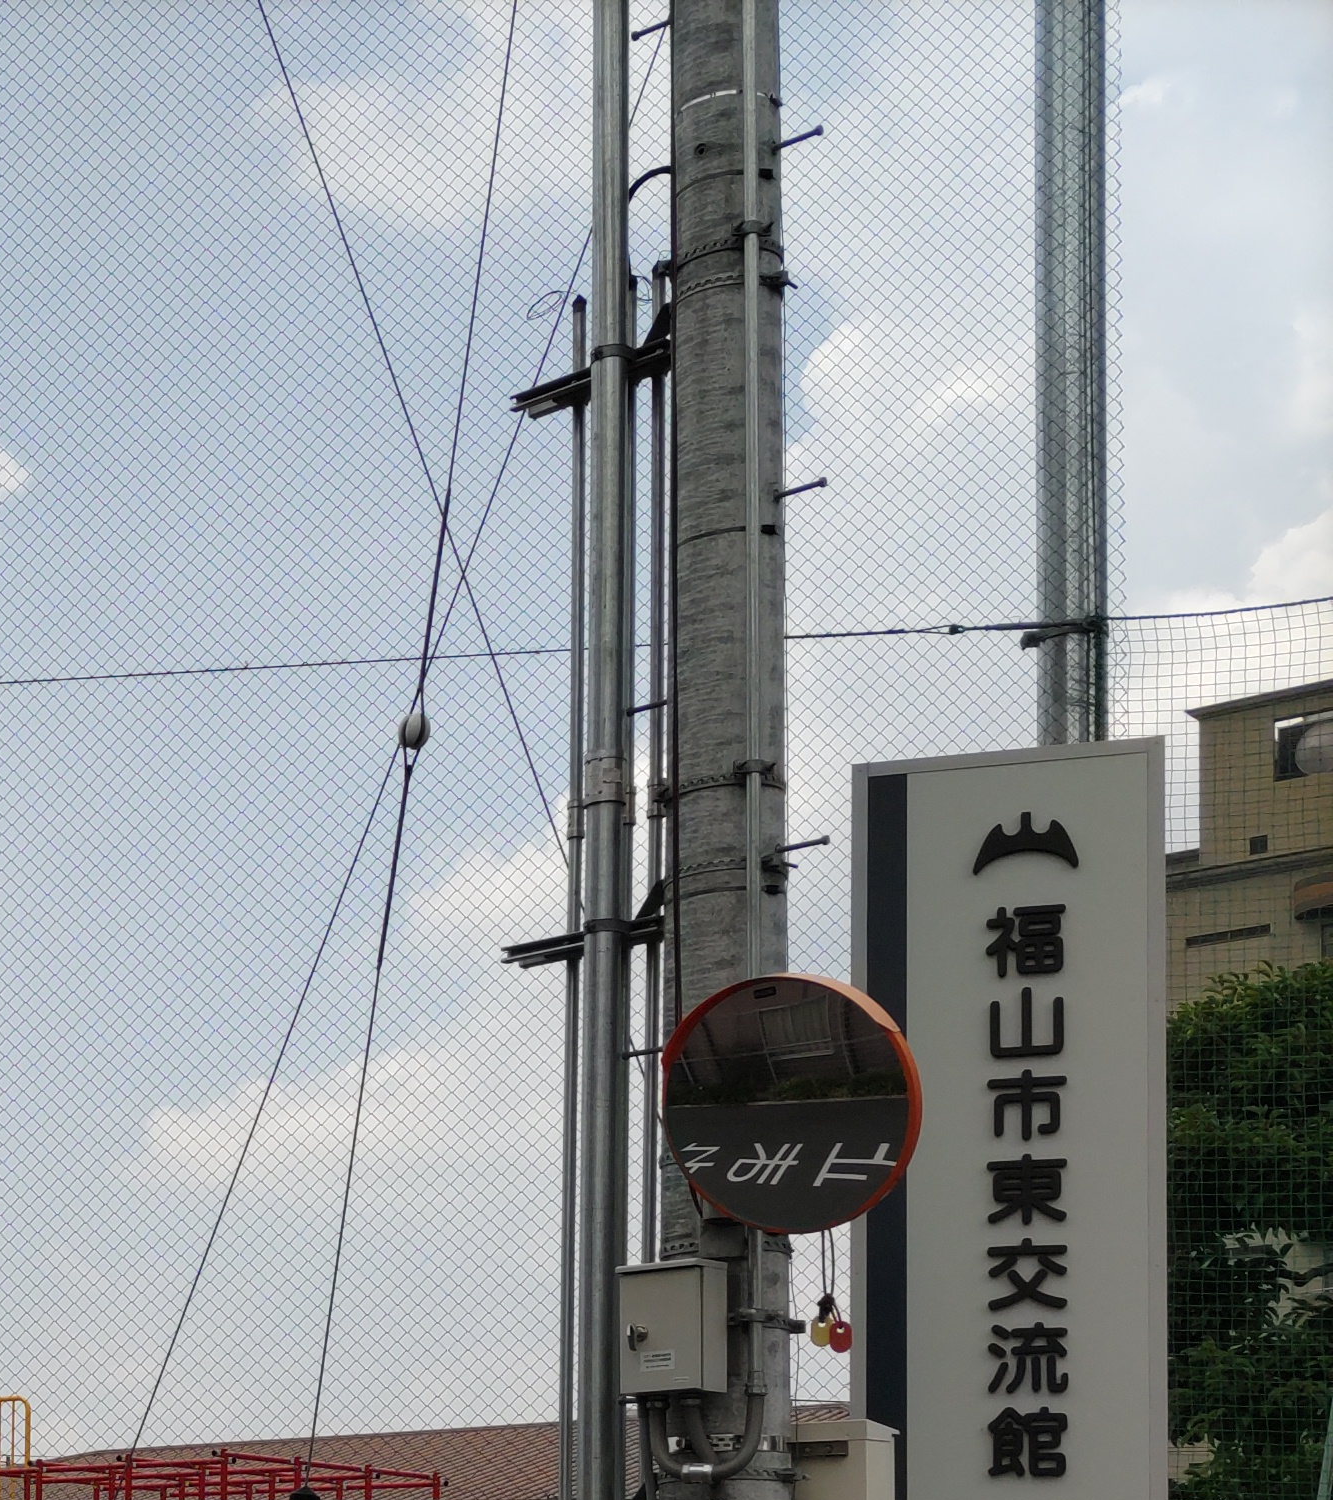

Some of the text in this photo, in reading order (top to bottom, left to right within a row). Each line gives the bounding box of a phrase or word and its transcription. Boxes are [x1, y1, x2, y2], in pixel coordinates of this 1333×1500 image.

[986, 903, 1069, 1478] 福山市東交流館
